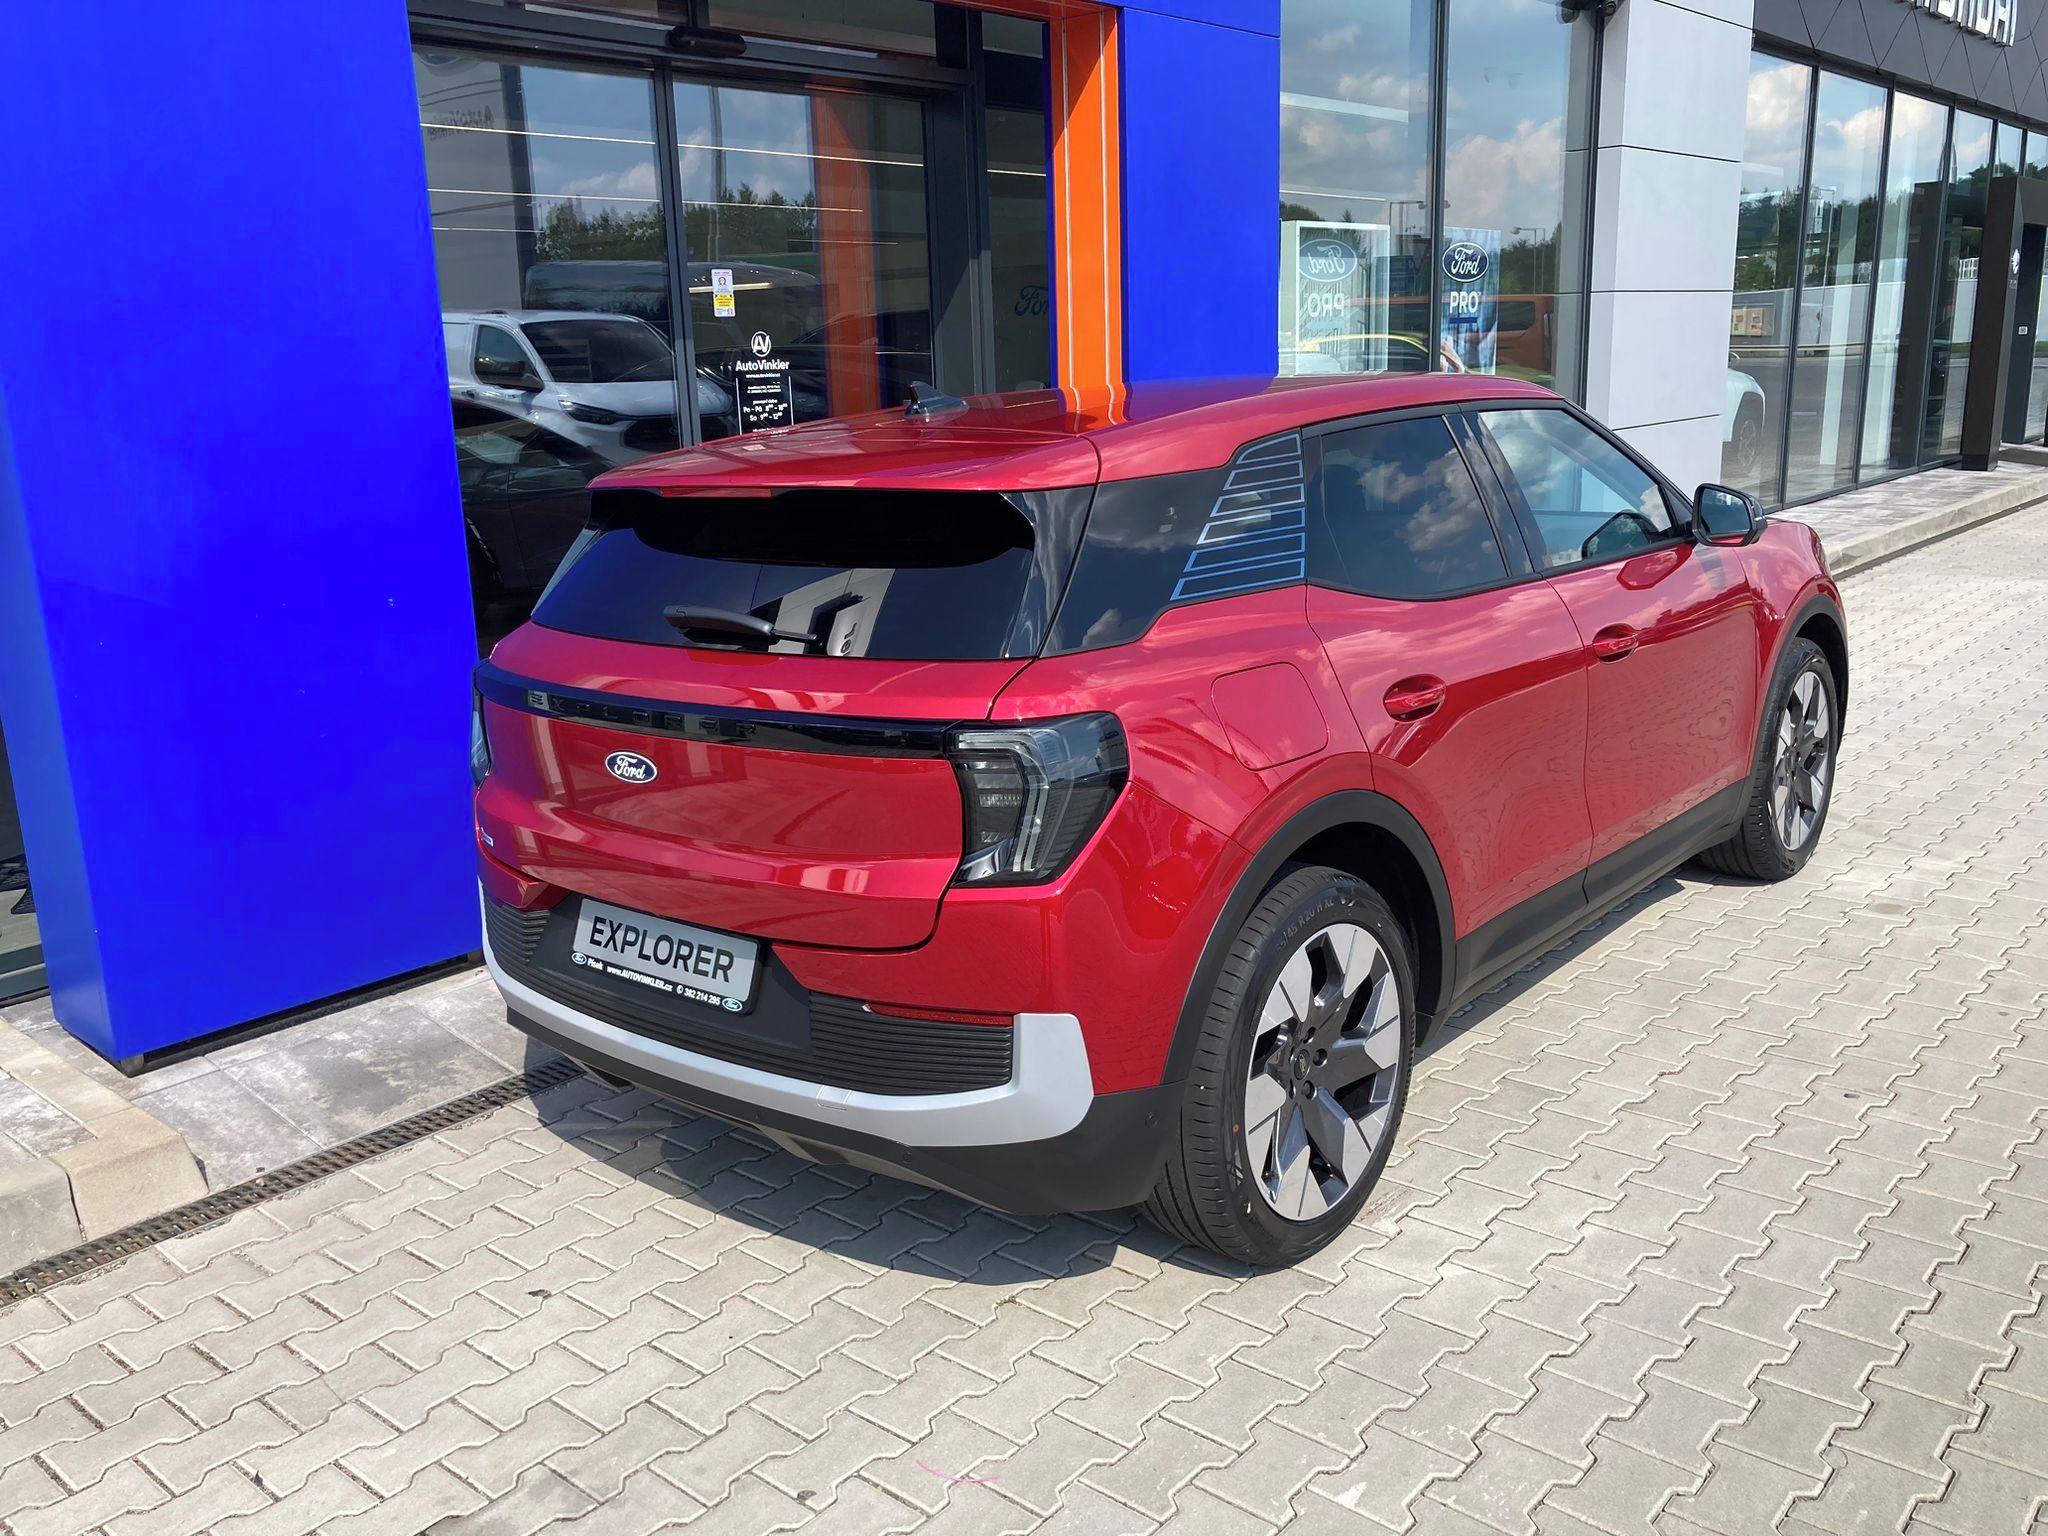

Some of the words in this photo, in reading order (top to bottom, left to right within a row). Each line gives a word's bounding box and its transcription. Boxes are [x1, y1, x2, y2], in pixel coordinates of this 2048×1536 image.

[1451, 247, 1480, 275] Ford
[735, 358, 790, 371] AutoVinkler
[613, 754, 647, 780] Ford
[590, 915, 734, 983] EXPLORER
[606, 965, 674, 992] www.AUTOVINKLER.cz
[684, 987, 696, 999] 382
[696, 991, 708, 1002] 214
